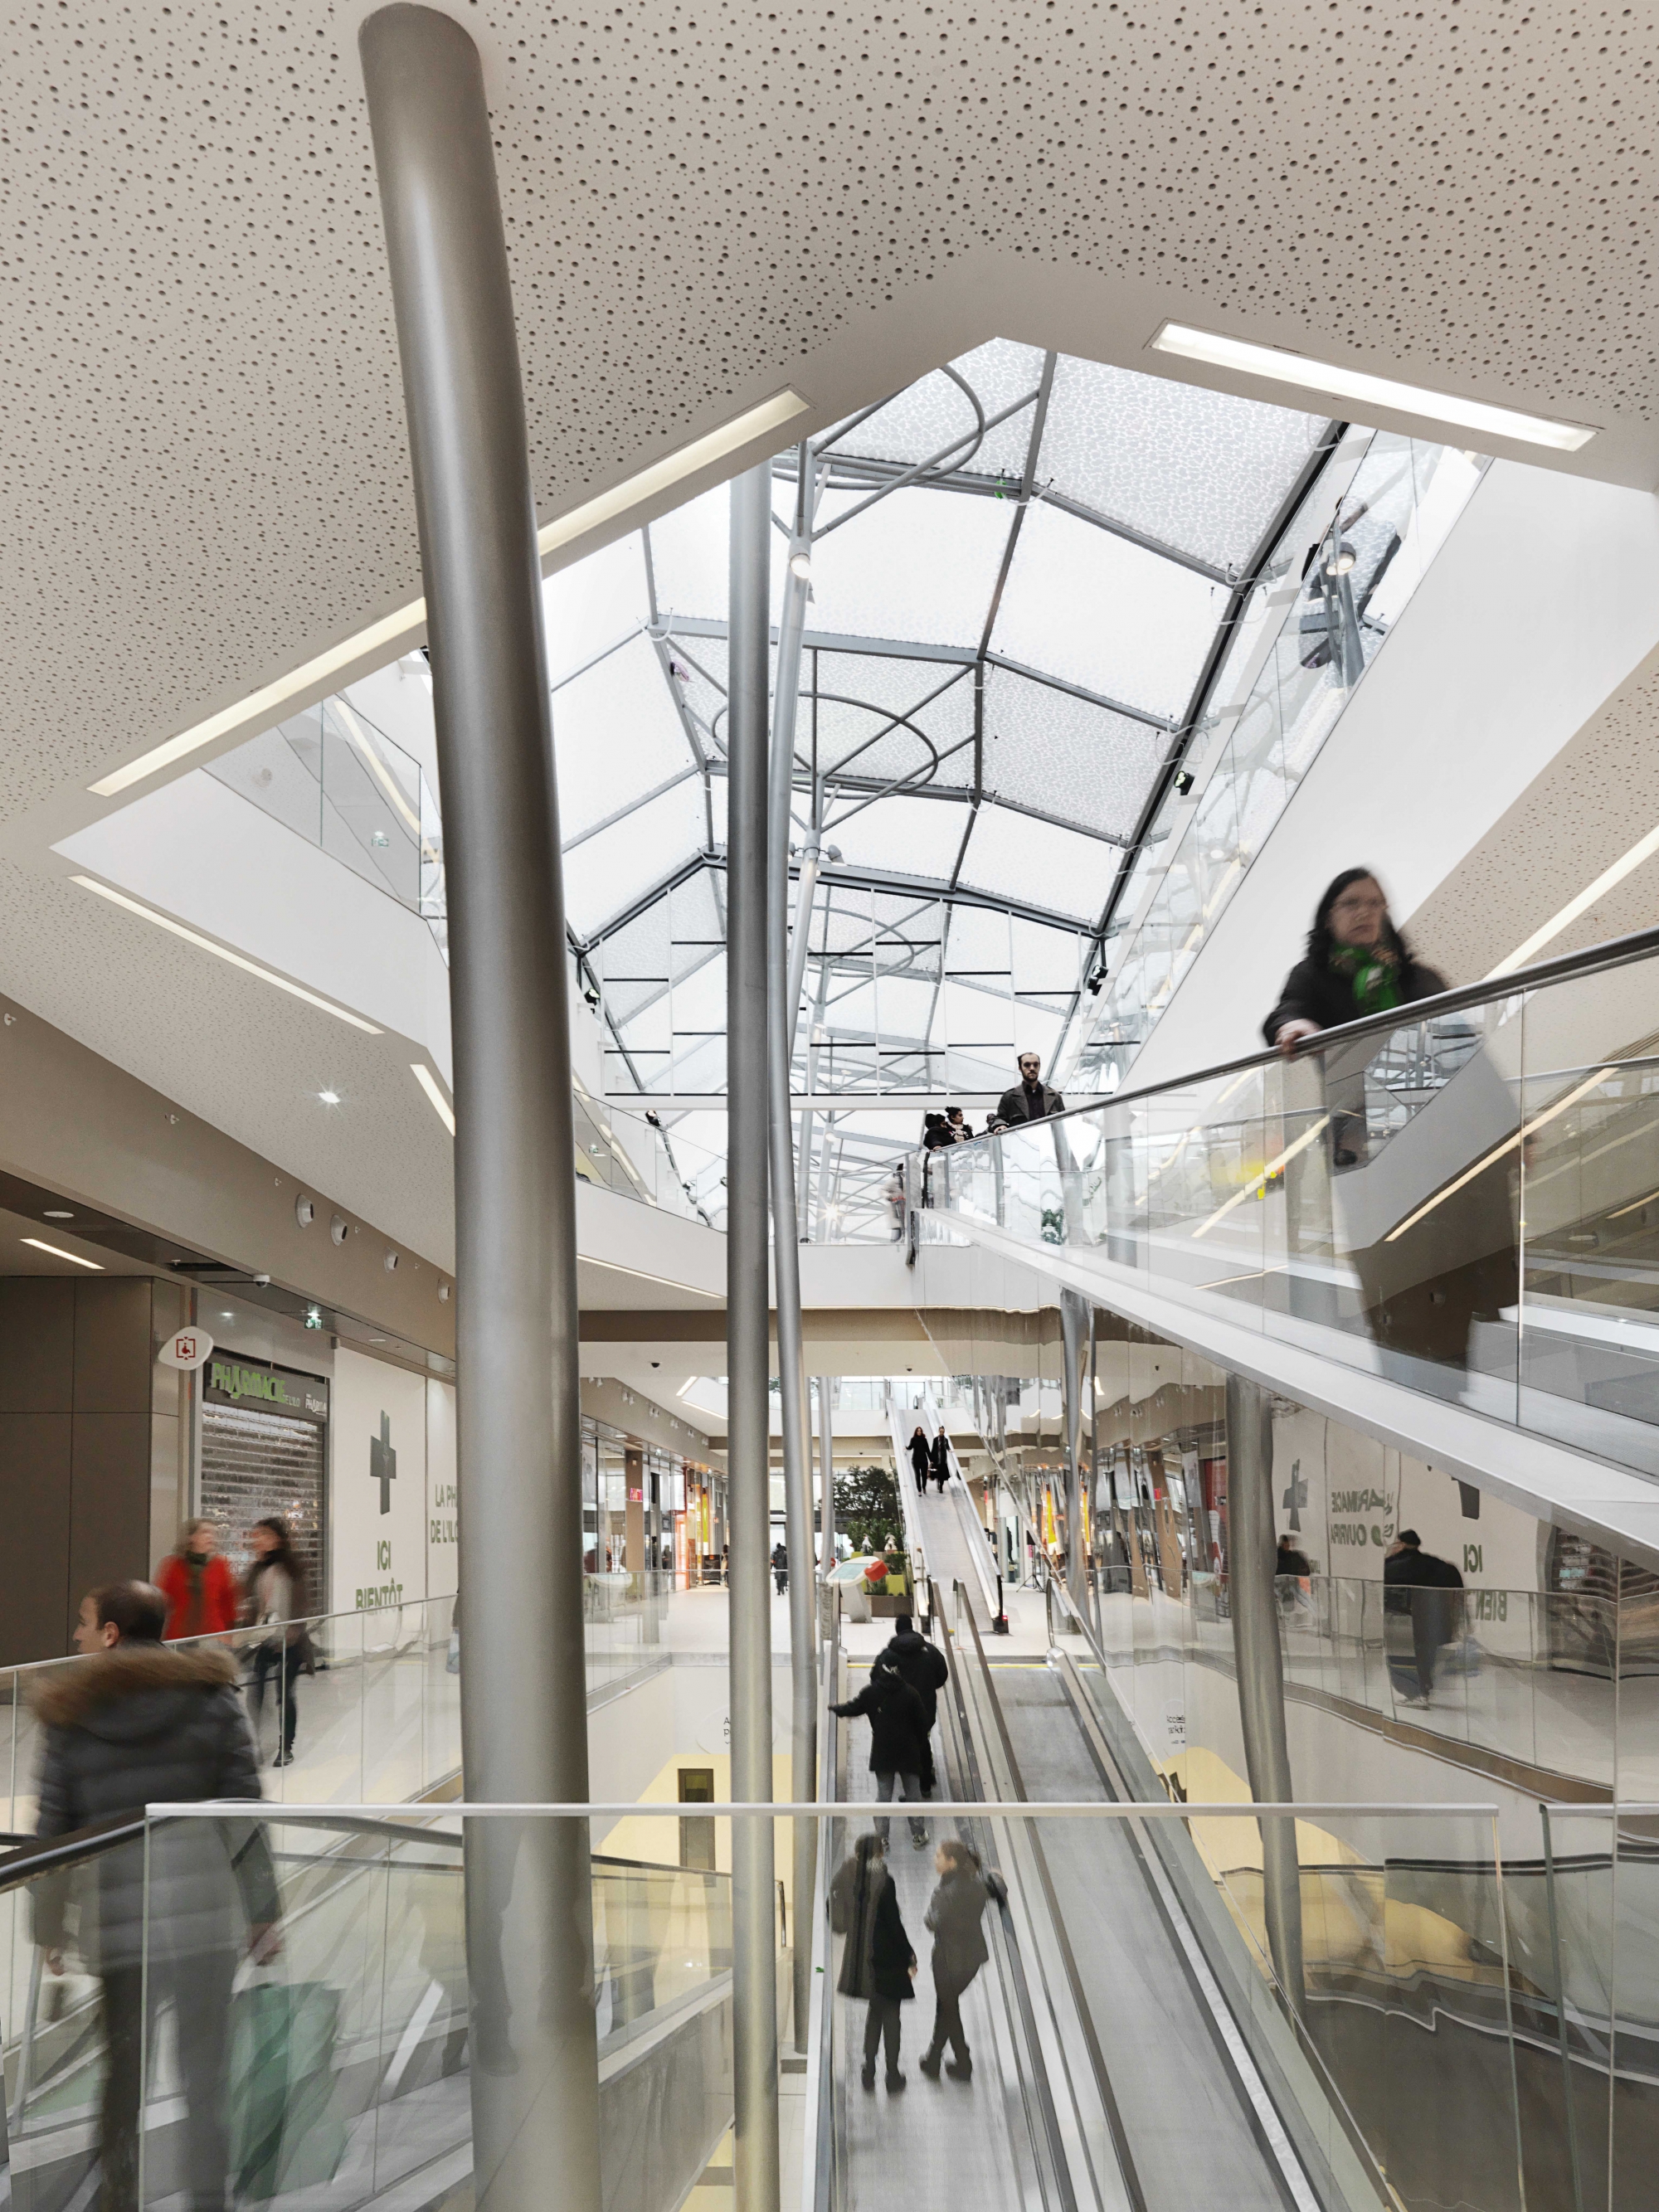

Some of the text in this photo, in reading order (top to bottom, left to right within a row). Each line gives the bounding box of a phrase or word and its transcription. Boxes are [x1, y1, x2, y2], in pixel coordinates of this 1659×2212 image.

[211, 1363, 285, 1403] PHARMACIE
[435, 1484, 457, 1507] LA PH
[431, 1519, 440, 1544] DE
[377, 1540, 391, 1570] ICI
[356, 1578, 402, 1611] BIENTÔT
